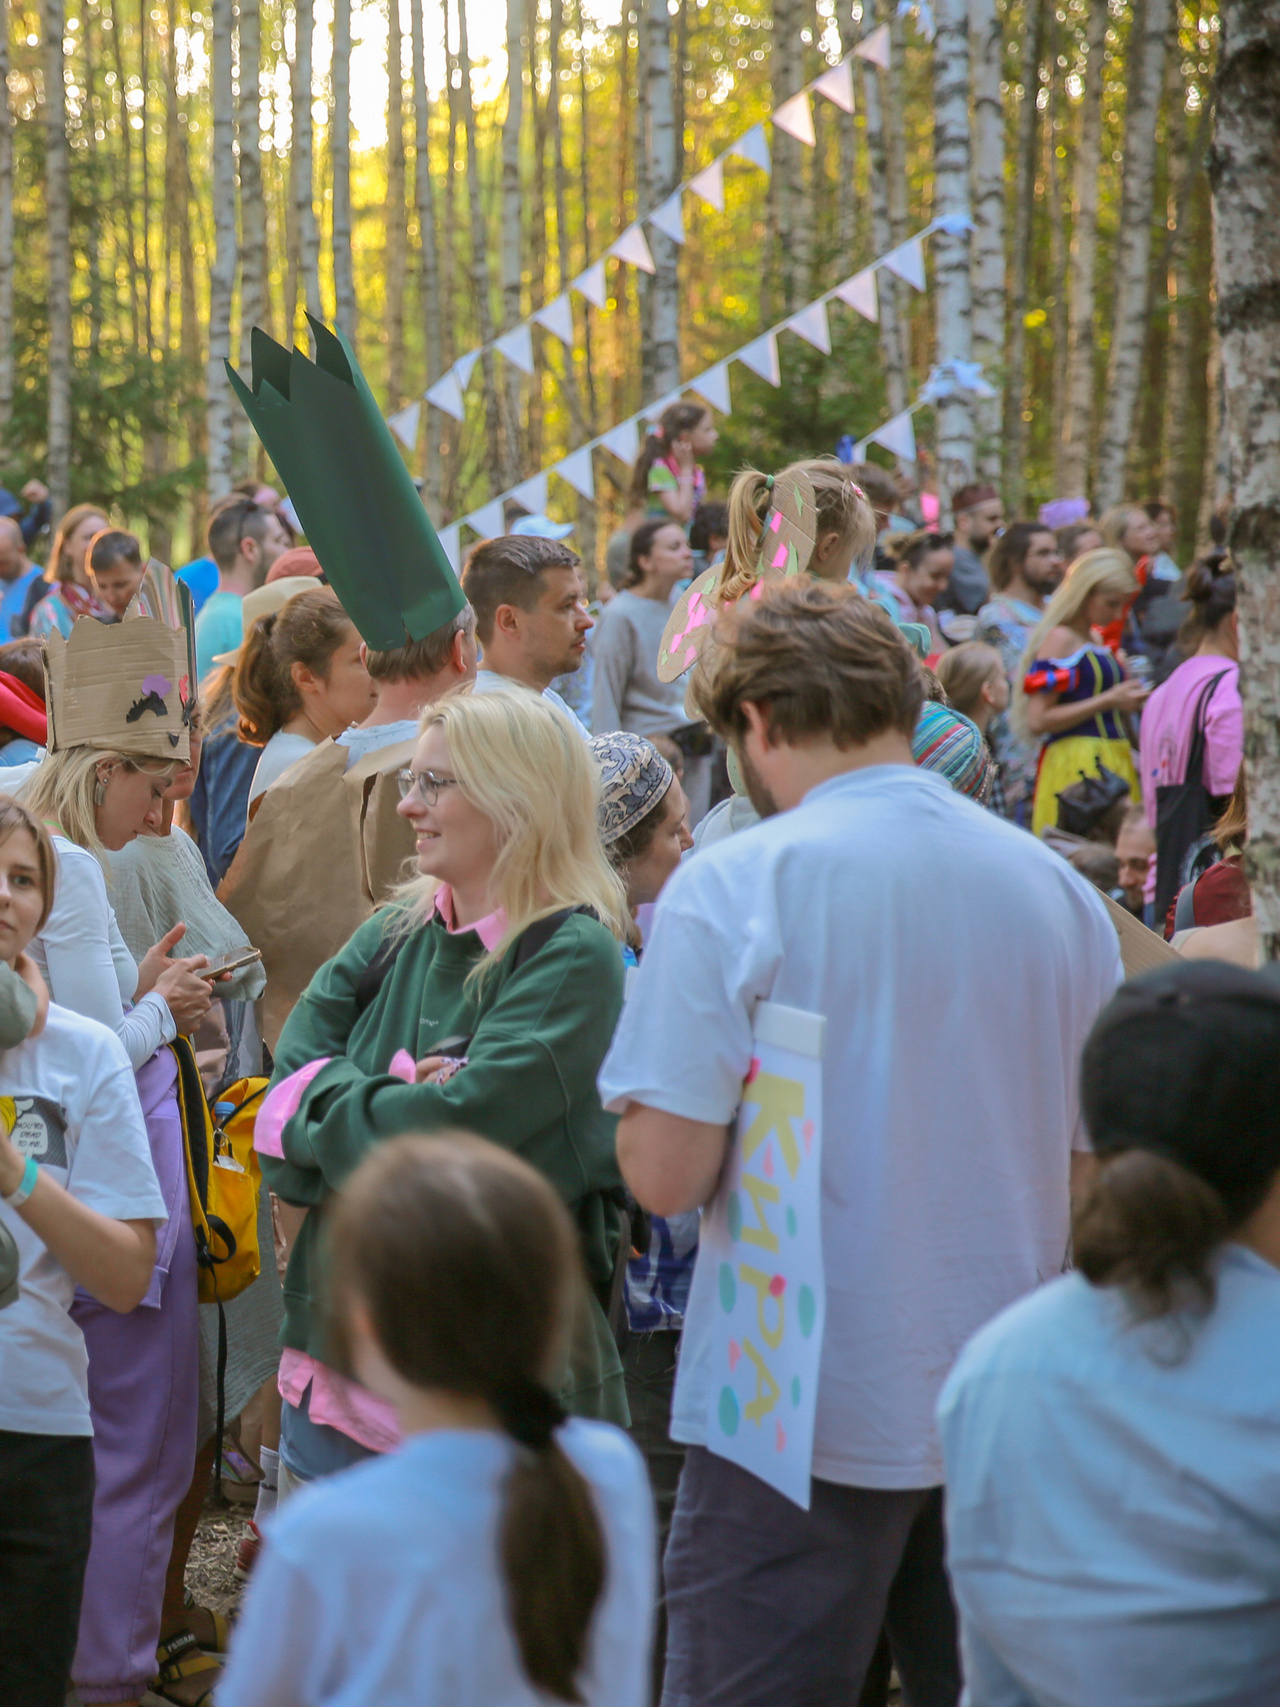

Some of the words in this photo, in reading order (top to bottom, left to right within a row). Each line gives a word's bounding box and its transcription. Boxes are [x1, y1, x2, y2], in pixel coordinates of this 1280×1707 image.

[16, 1122, 43, 1130] YOU'RE
[20, 1131, 42, 1139] DEAD
[18, 1140, 27, 1148] TO
[739, 1070, 806, 1428] КИРА
